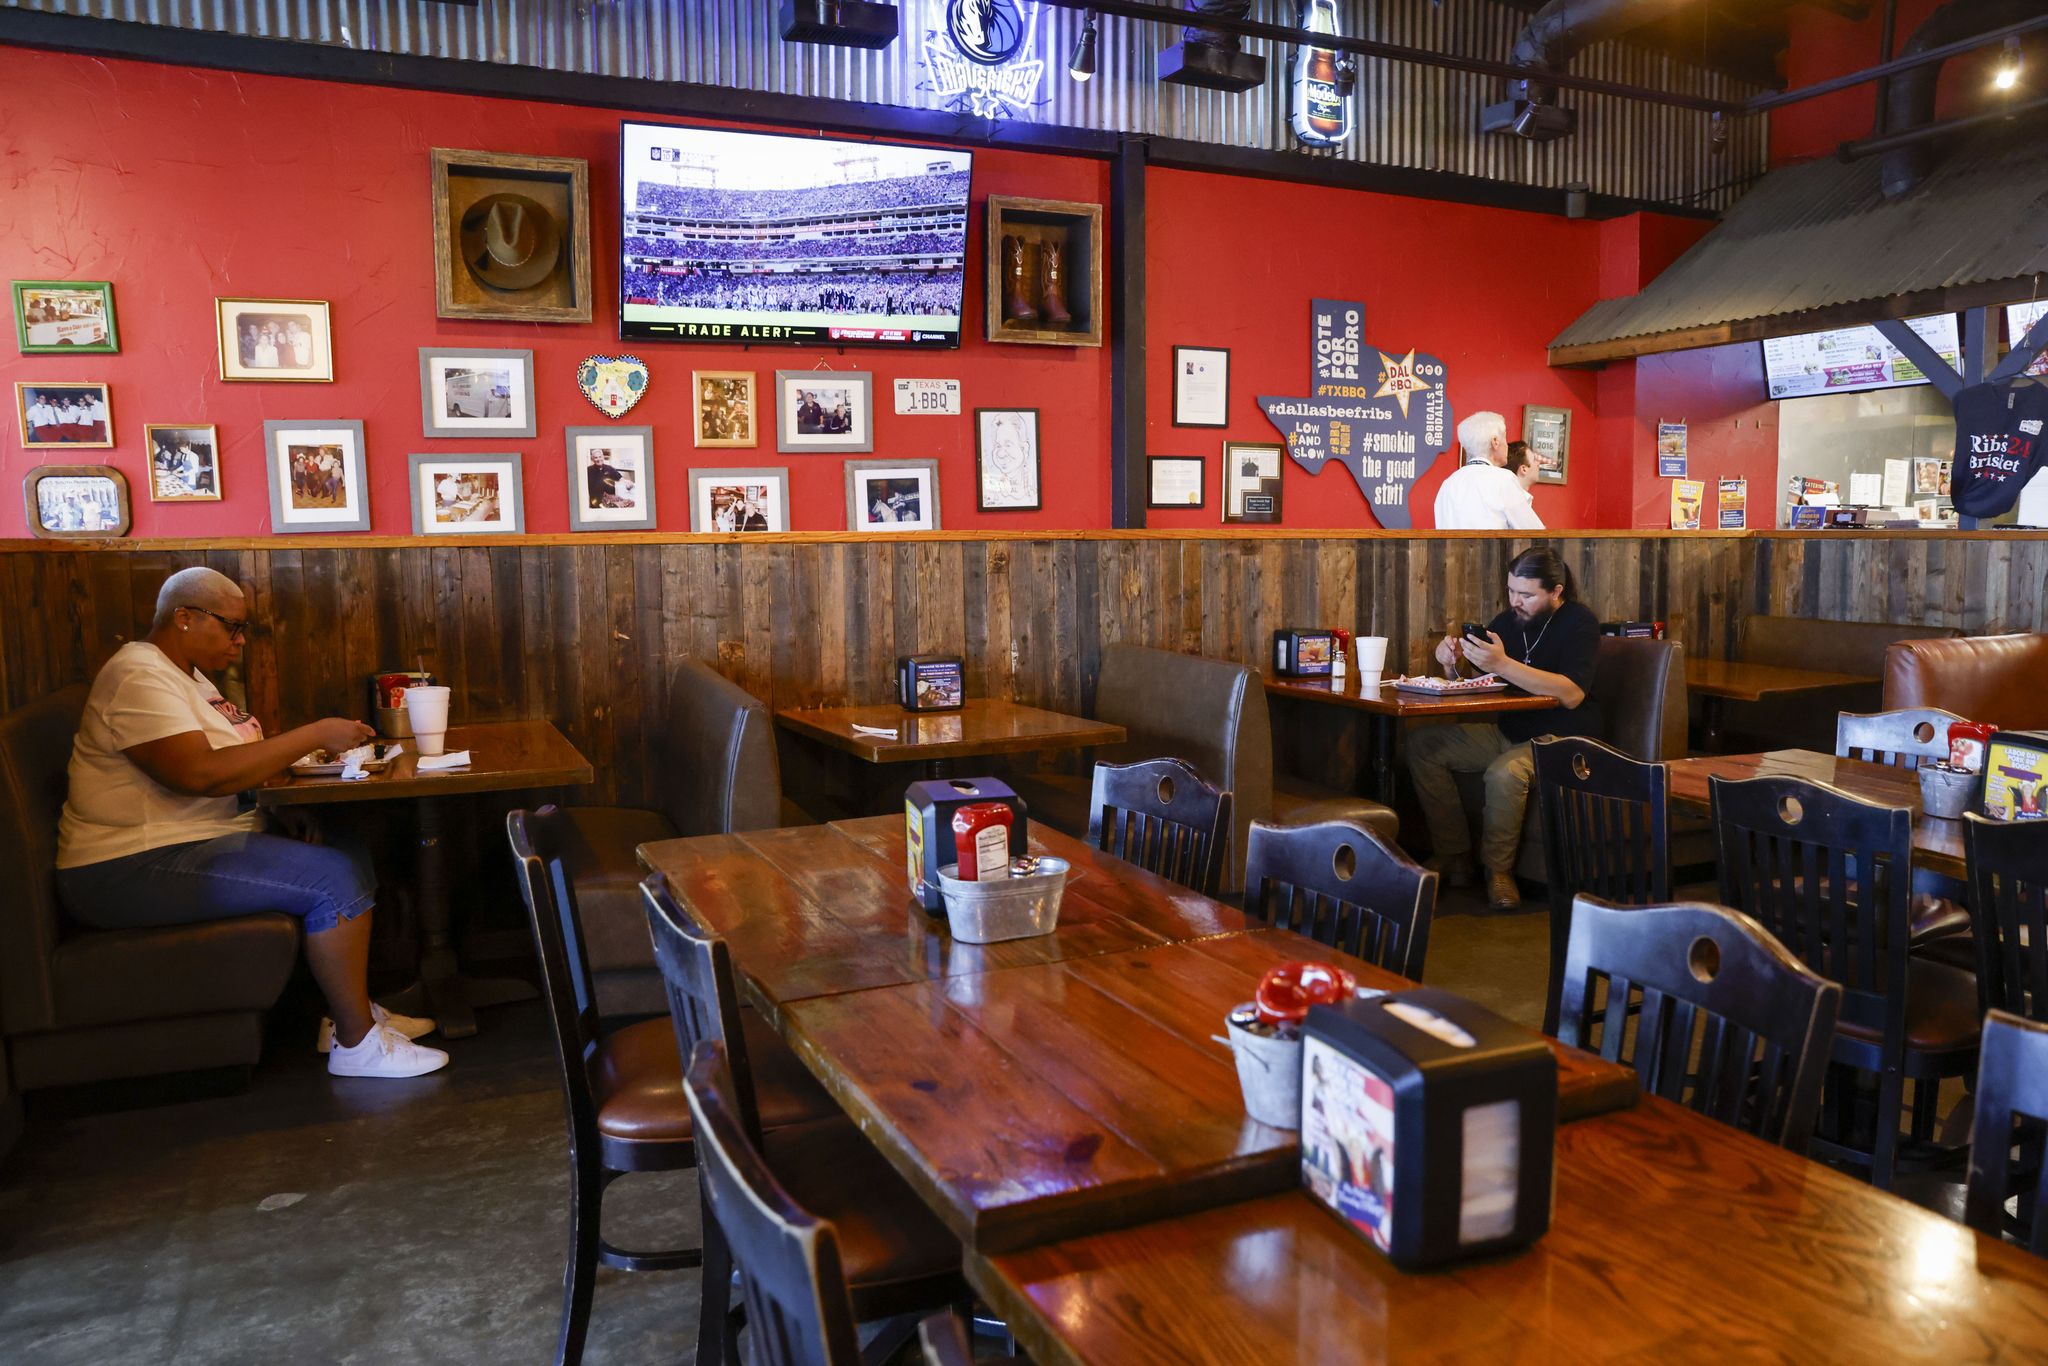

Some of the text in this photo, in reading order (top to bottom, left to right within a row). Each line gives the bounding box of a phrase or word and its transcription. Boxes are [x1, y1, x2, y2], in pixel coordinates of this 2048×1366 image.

[678, 324, 792, 338] TRADE ALERT
[1317, 314, 1332, 378] #VOTE
[1345, 310, 1359, 380] PEDRO
[1331, 337, 1345, 379] FOR
[1389, 365, 1410, 379] DAL
[915, 381, 940, 389] TEXAS
[1317, 384, 1366, 400] #TXBBQ
[1390, 379, 1413, 391] BBQ
[1268, 402, 1393, 420] #dallasbeefribs
[1424, 392, 1435, 446] @BIGALS
[1295, 421, 1320, 434] LOW
[1362, 430, 1416, 454] #smokin
[1970, 434, 2009, 454] Ribs
[1294, 447, 1325, 459] SLOW
[1362, 455, 1415, 483] the good
[1374, 483, 1404, 506] stuff
[2004, 748, 2041, 761] LABOR DAY
